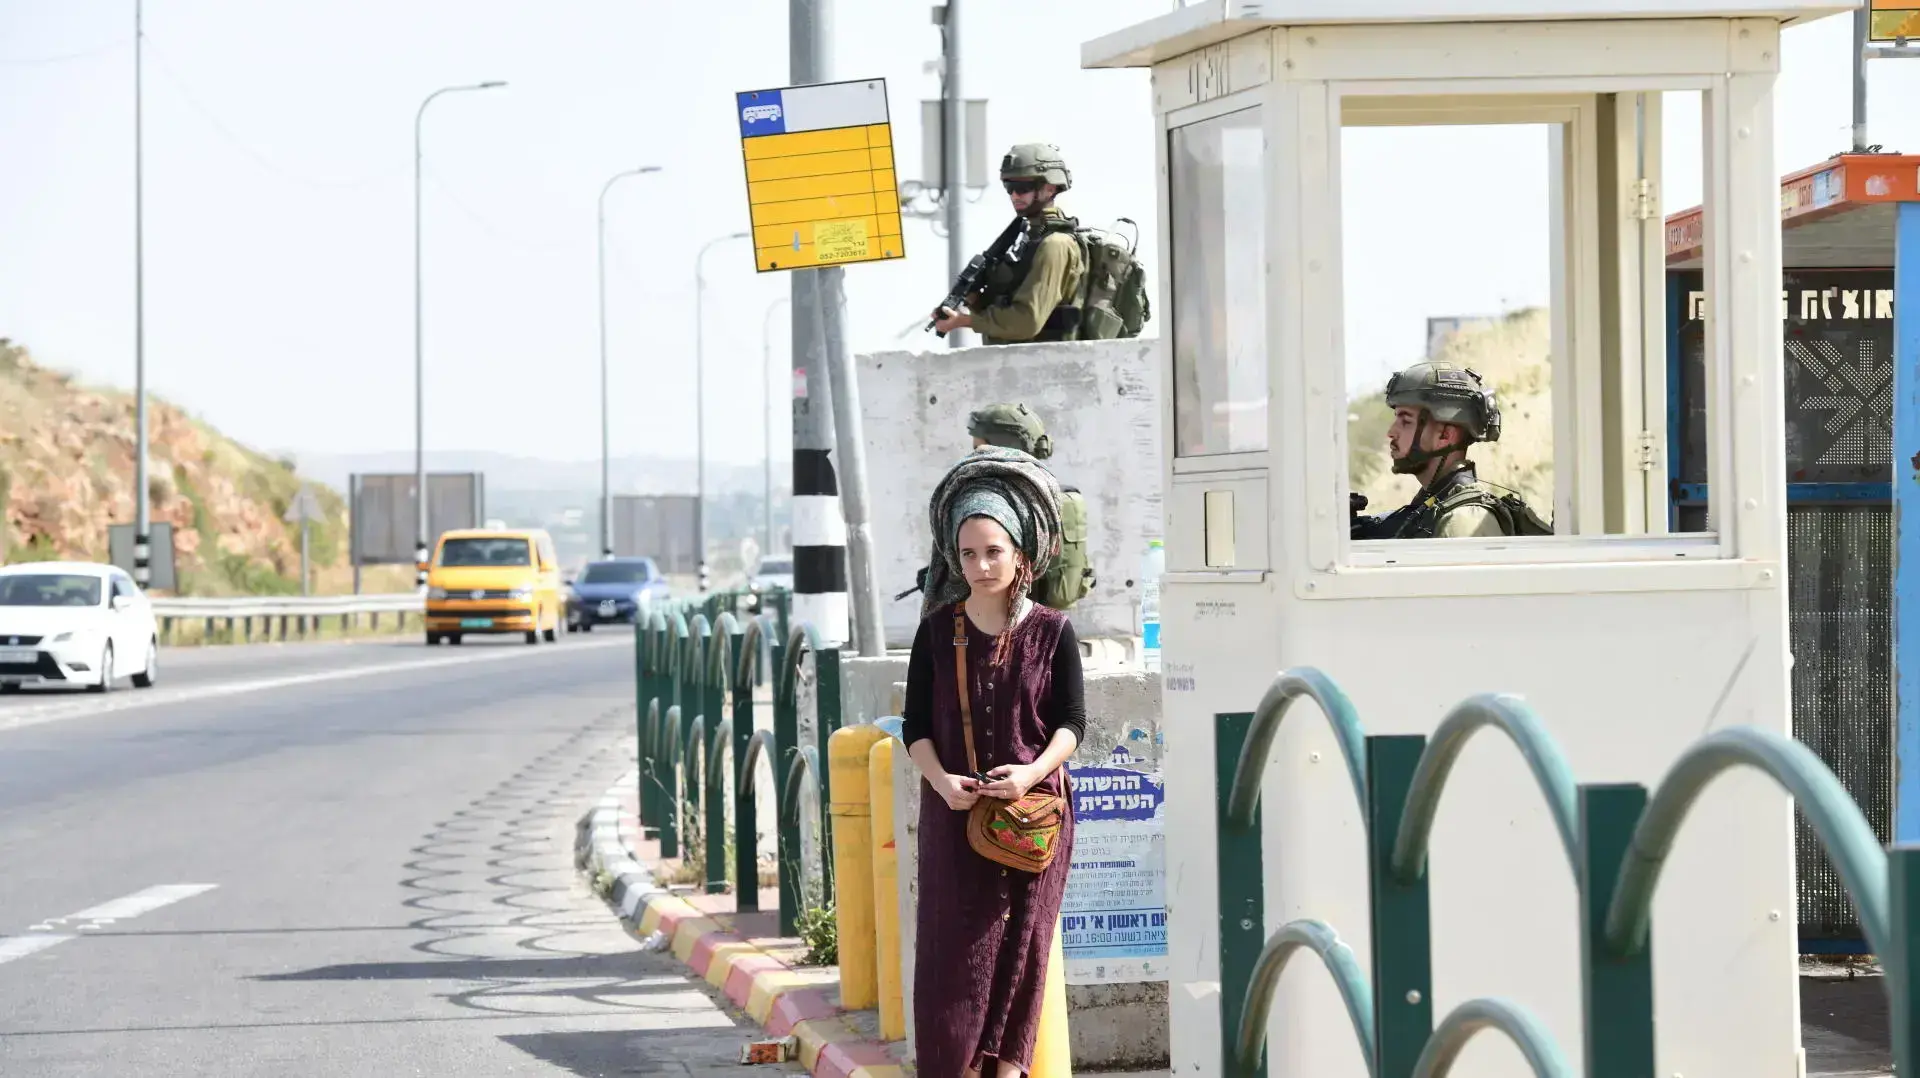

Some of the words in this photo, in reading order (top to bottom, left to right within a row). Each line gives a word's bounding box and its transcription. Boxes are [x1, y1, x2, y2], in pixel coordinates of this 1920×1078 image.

[1070, 775, 1141, 792] ההשתל
[1079, 794, 1154, 811] הערבית
[1062, 915, 1086, 933] ניסן
[1108, 913, 1147, 931] ראשון
[1086, 933, 1112, 944] 16:00
[1114, 931, 1141, 942] בשעה
[1145, 930, 1167, 941] ציאה
